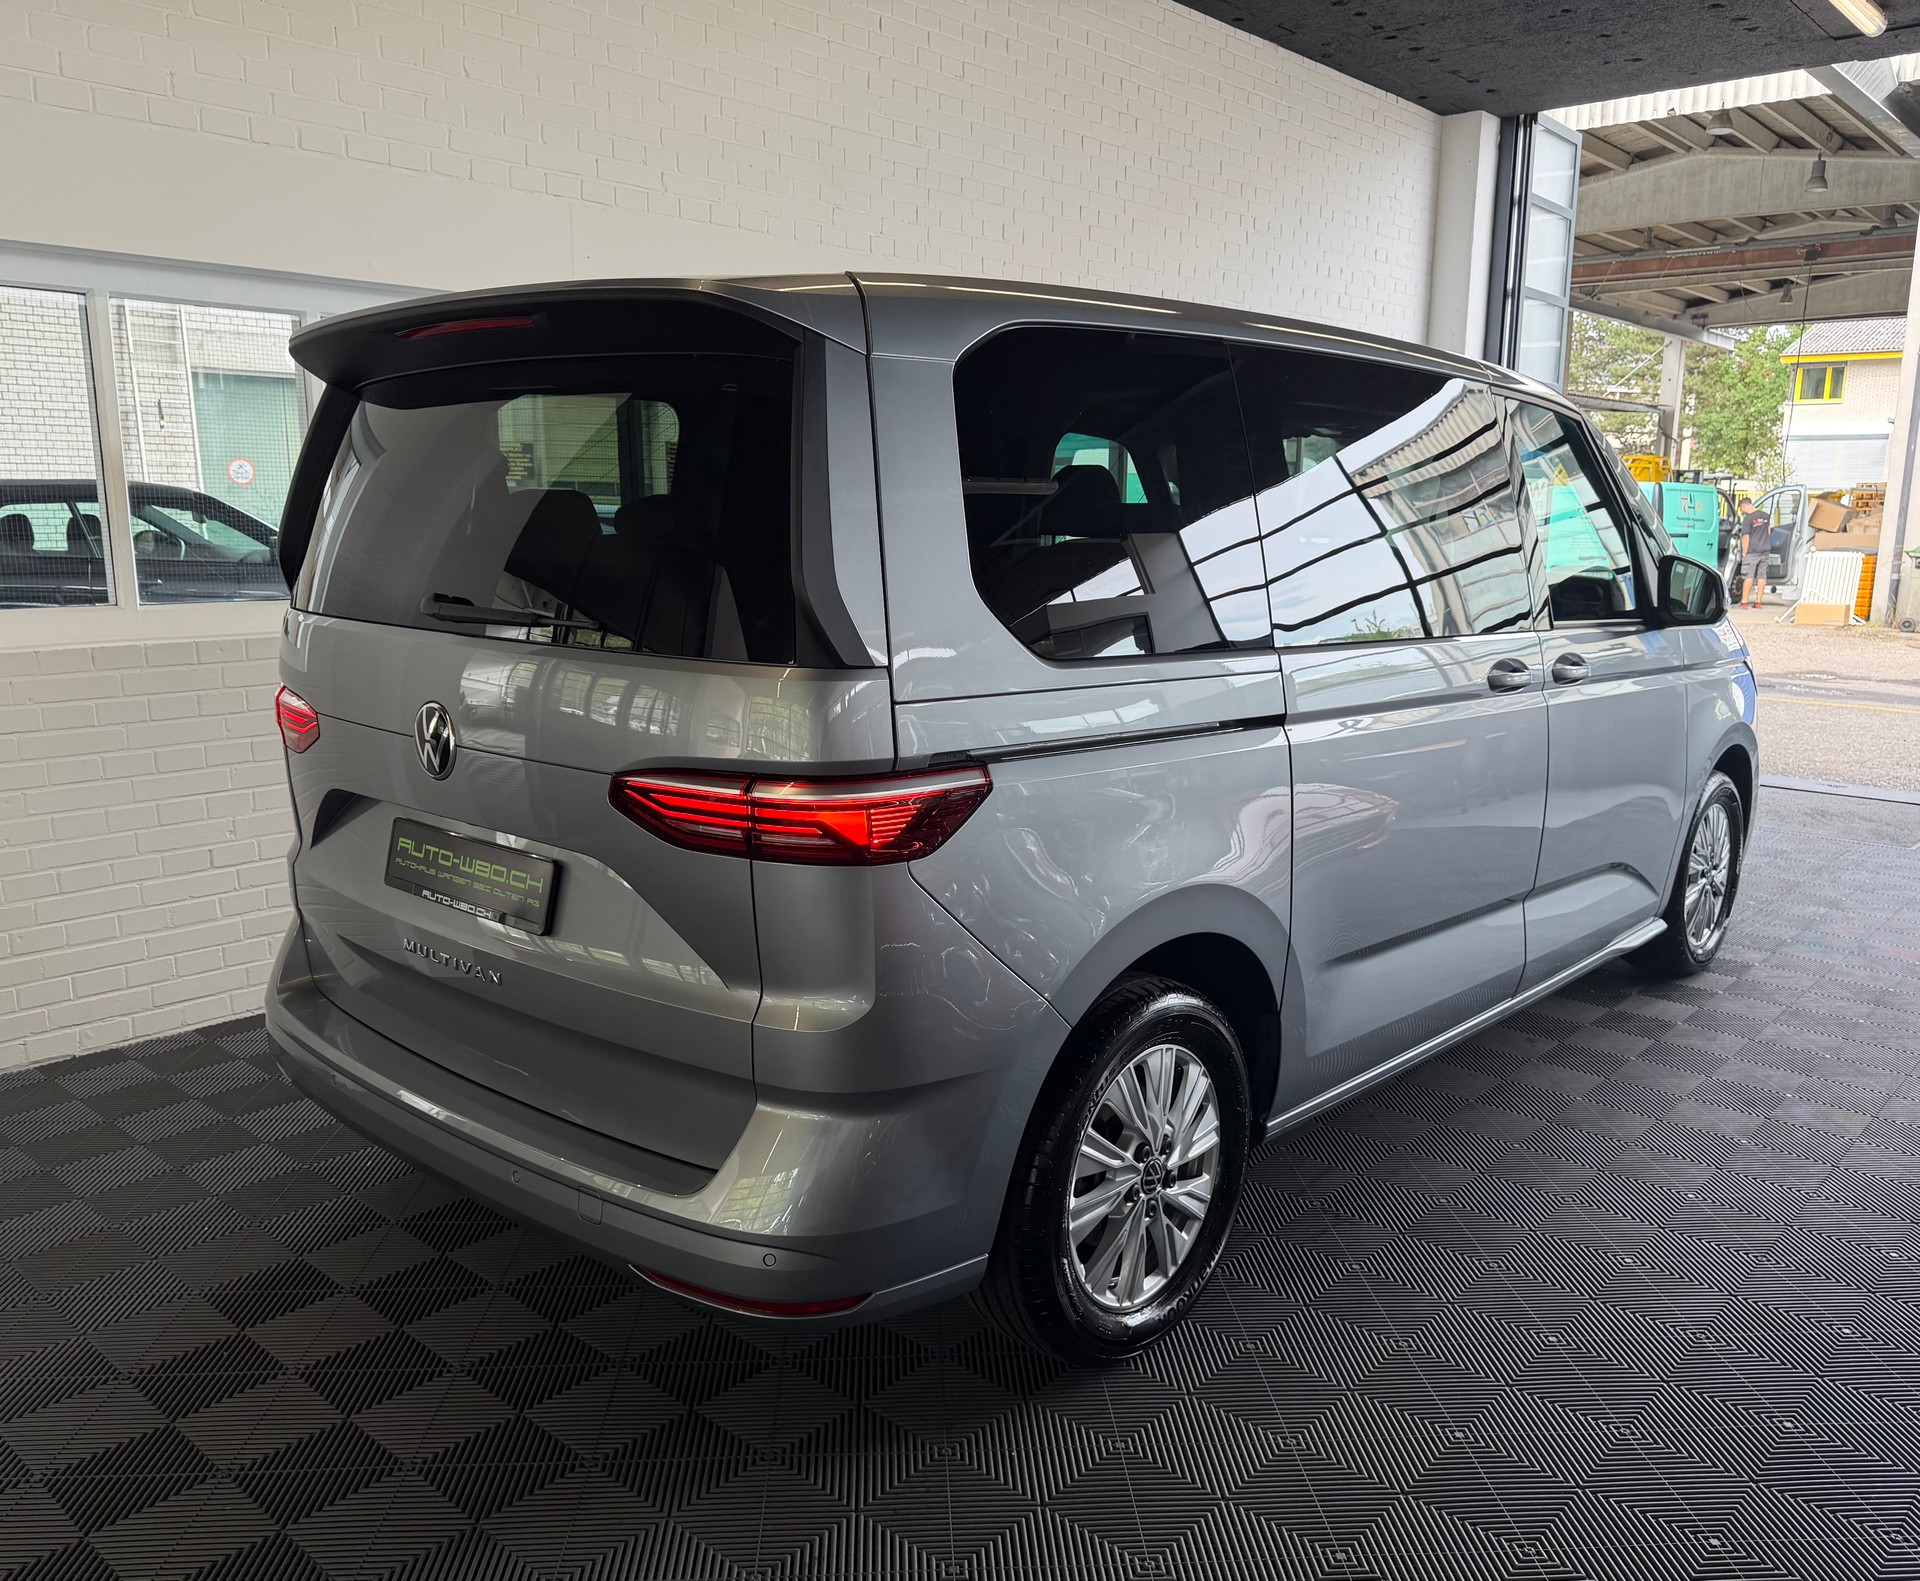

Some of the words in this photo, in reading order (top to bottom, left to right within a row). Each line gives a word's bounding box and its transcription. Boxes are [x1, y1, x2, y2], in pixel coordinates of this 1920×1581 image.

[395, 857, 436, 877] AUTOHAUS
[438, 870, 471, 887] WANGEN
[397, 837, 544, 893] AUTO-WBO.CH
[403, 937, 502, 986] MULTIVAN
